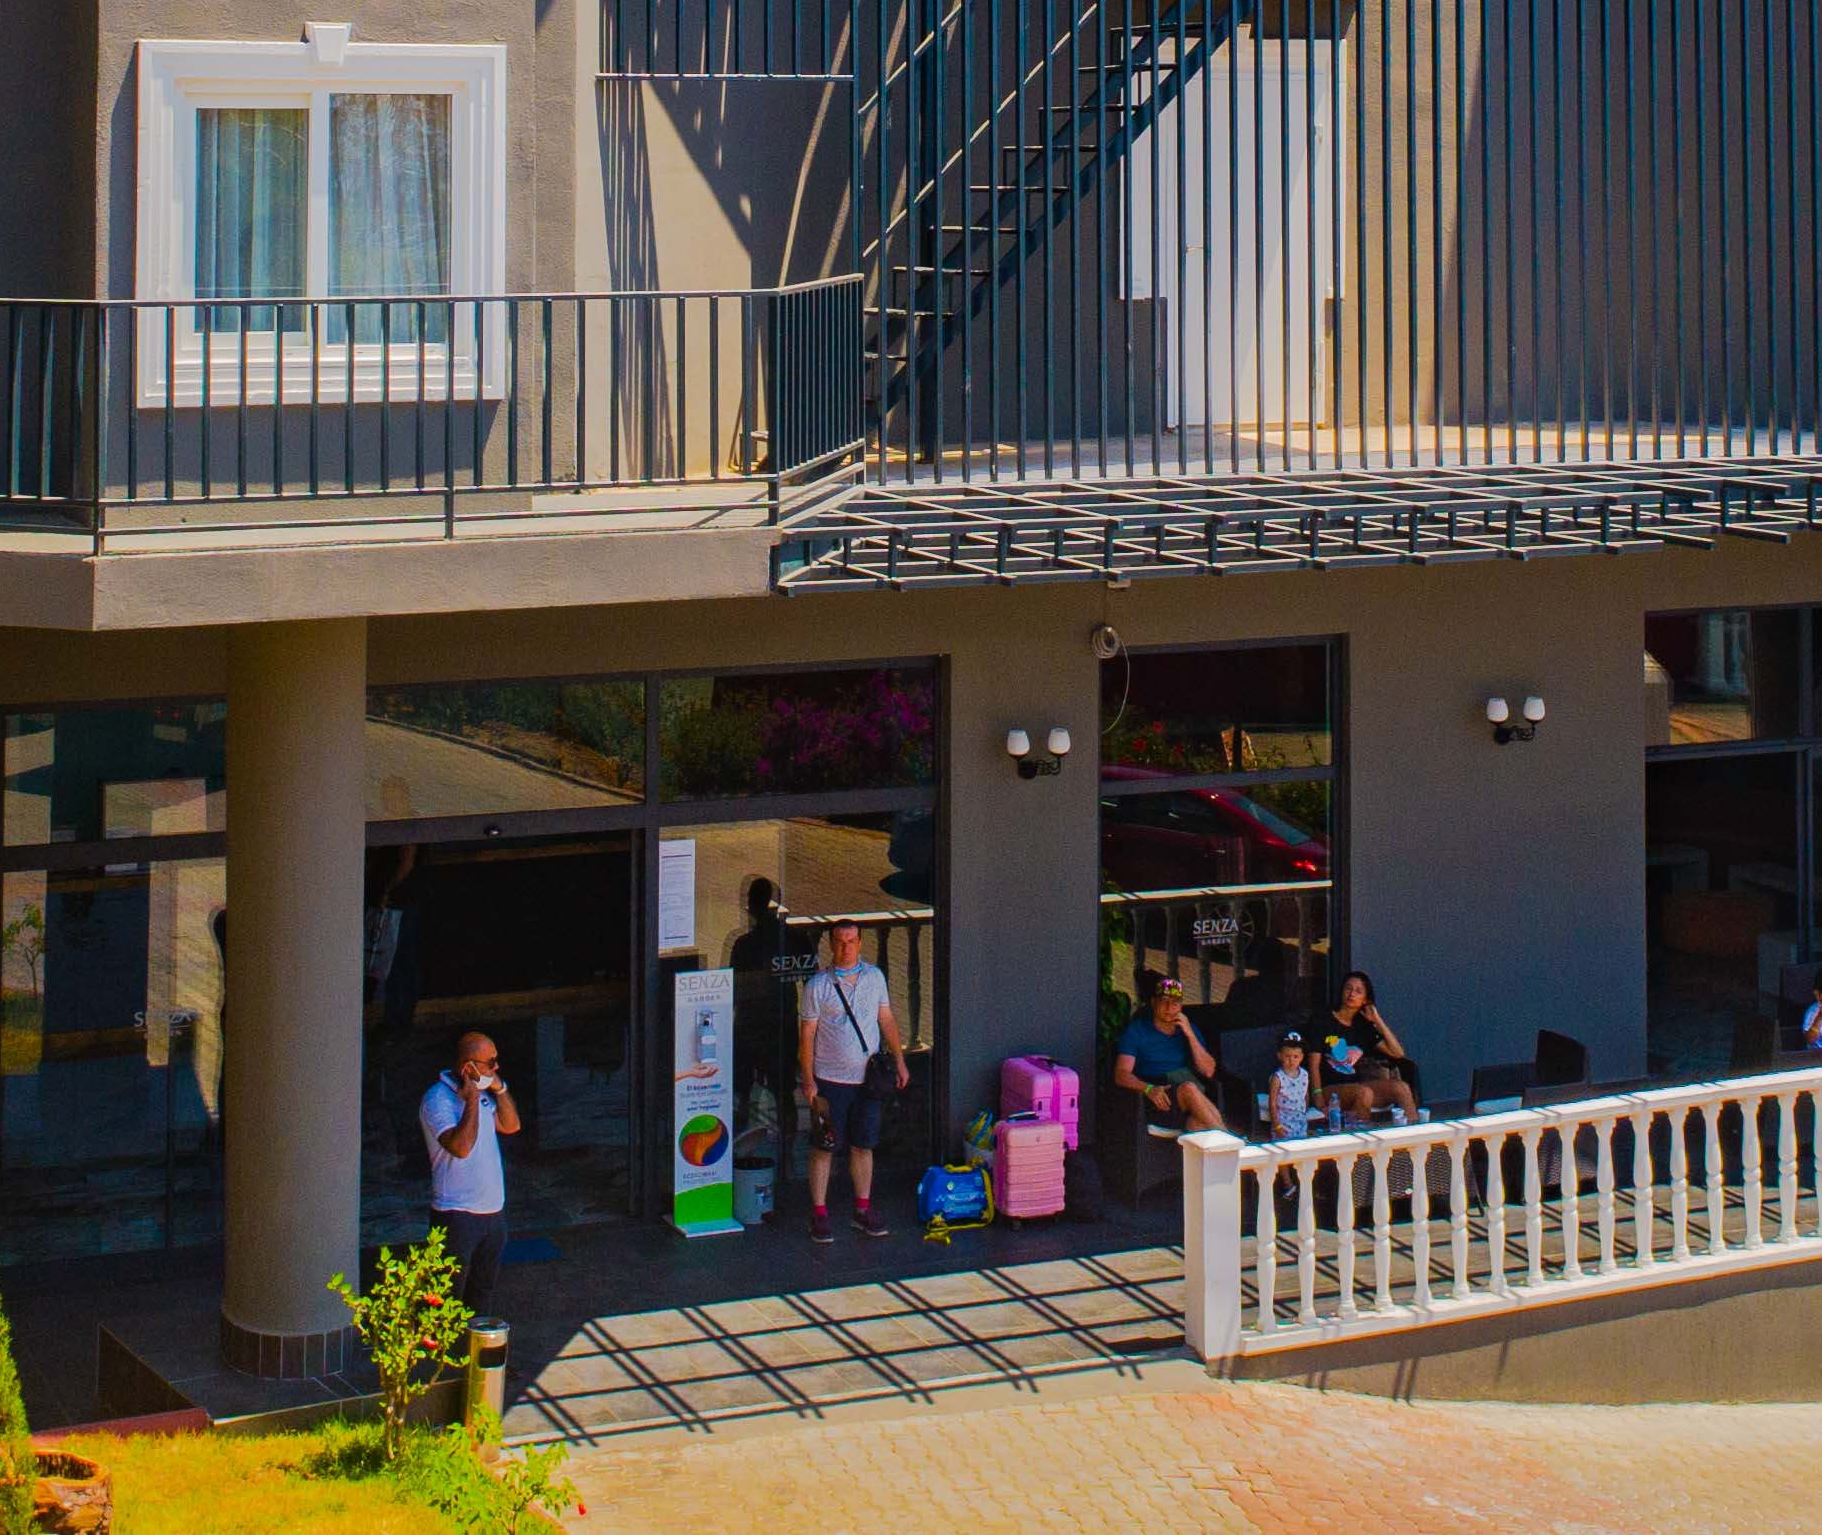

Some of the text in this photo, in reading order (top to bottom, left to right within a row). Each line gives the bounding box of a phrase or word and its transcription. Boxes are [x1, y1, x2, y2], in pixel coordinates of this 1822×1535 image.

[1192, 918, 1239, 935] SENZA
[771, 953, 819, 972] SENZA
[679, 974, 730, 992] SENZA
